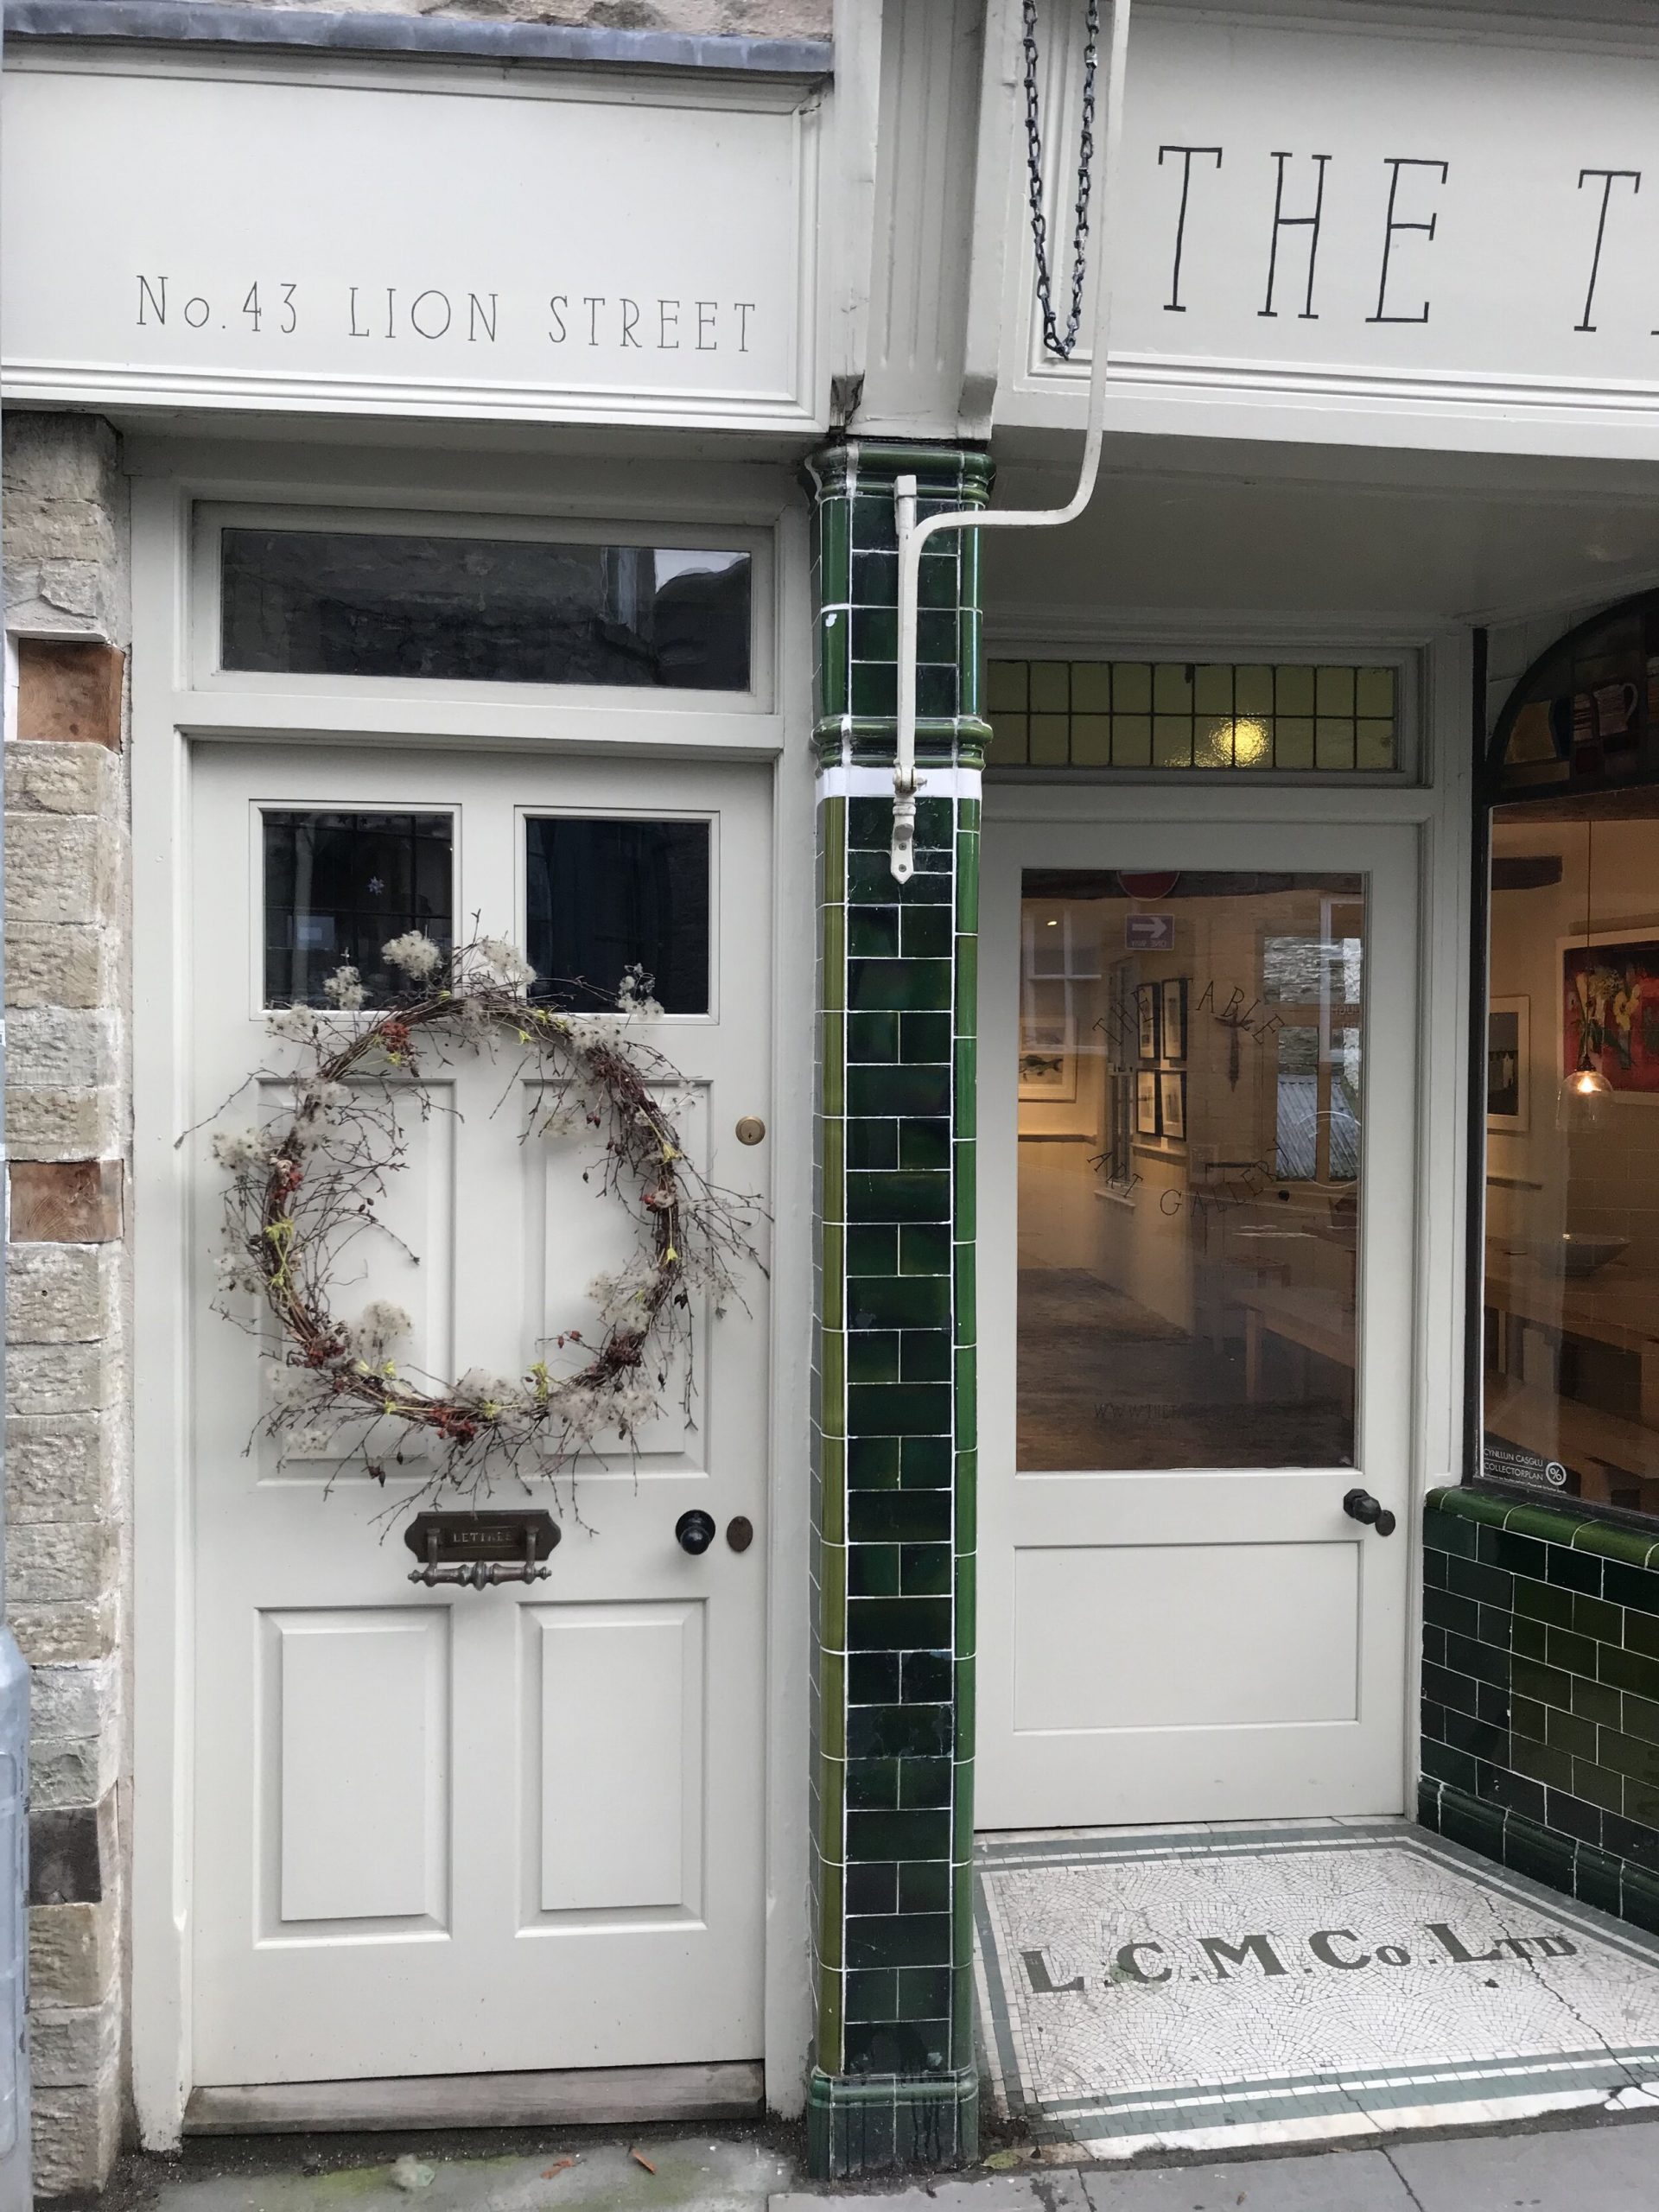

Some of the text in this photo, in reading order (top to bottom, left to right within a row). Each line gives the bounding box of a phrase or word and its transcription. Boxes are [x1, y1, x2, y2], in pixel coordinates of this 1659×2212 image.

[1156, 145, 1659, 335] THE T
[348, 286, 499, 344] LION
[548, 295, 757, 353] STREET
[1092, 988, 1155, 1046] THE
[1086, 1138, 1290, 1217] ART GALLERY
[1484, 1462, 1543, 1480] COLLECTORPLAN
[1516, 1455, 1542, 1466] CASGLU
